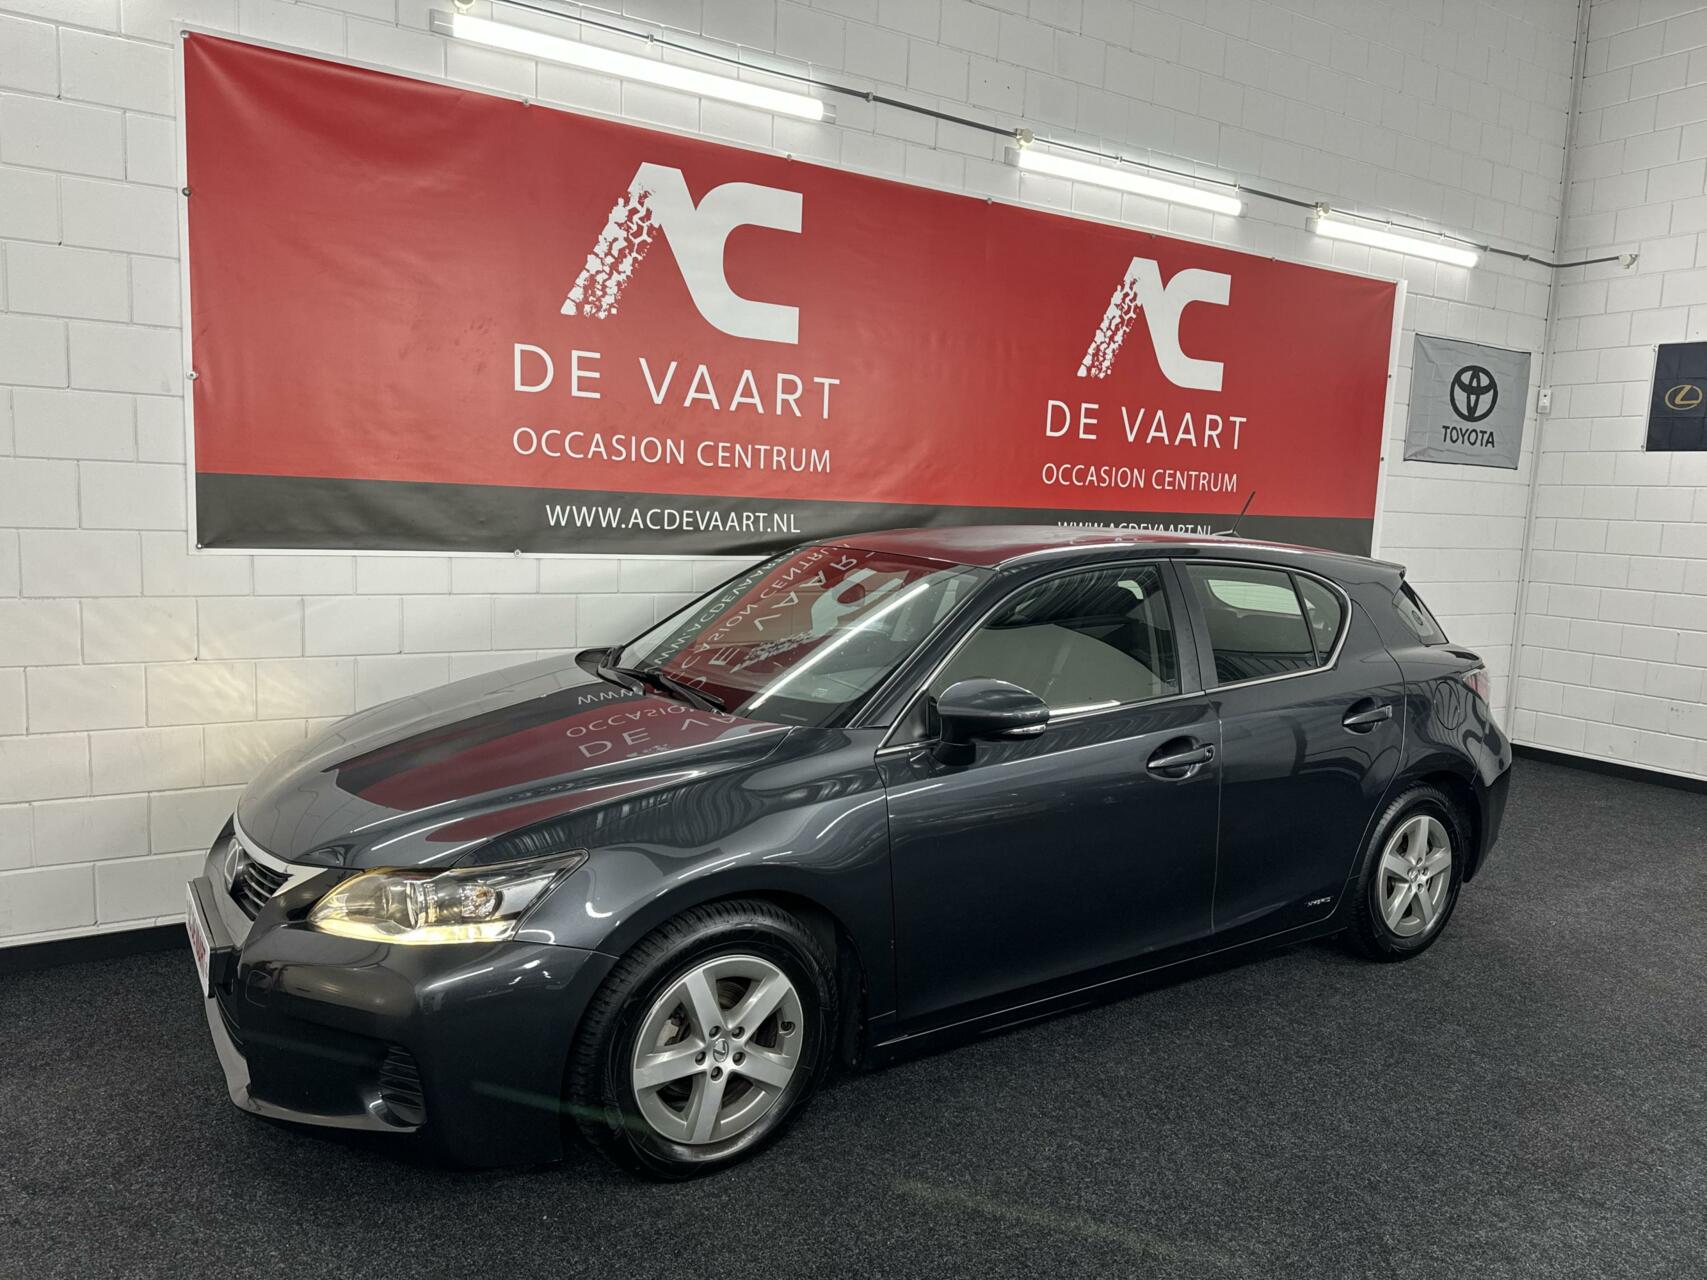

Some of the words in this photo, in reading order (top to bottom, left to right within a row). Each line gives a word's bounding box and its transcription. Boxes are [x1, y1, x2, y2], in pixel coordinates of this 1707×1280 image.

[561, 162, 803, 344] AC
[1077, 257, 1231, 391] AC
[514, 343, 601, 399] DE
[639, 357, 840, 419] VAART
[1046, 400, 1099, 439] DE
[1121, 406, 1247, 450] VAART
[1442, 425, 1495, 448] TOYOTA
[513, 427, 684, 465] OCCASION
[697, 441, 831, 473] CENTRUM
[1042, 463, 1145, 489] OCCASION
[1152, 469, 1237, 492] CENTRUM
[545, 504, 801, 533] WWW.ACDEVAART.NL
